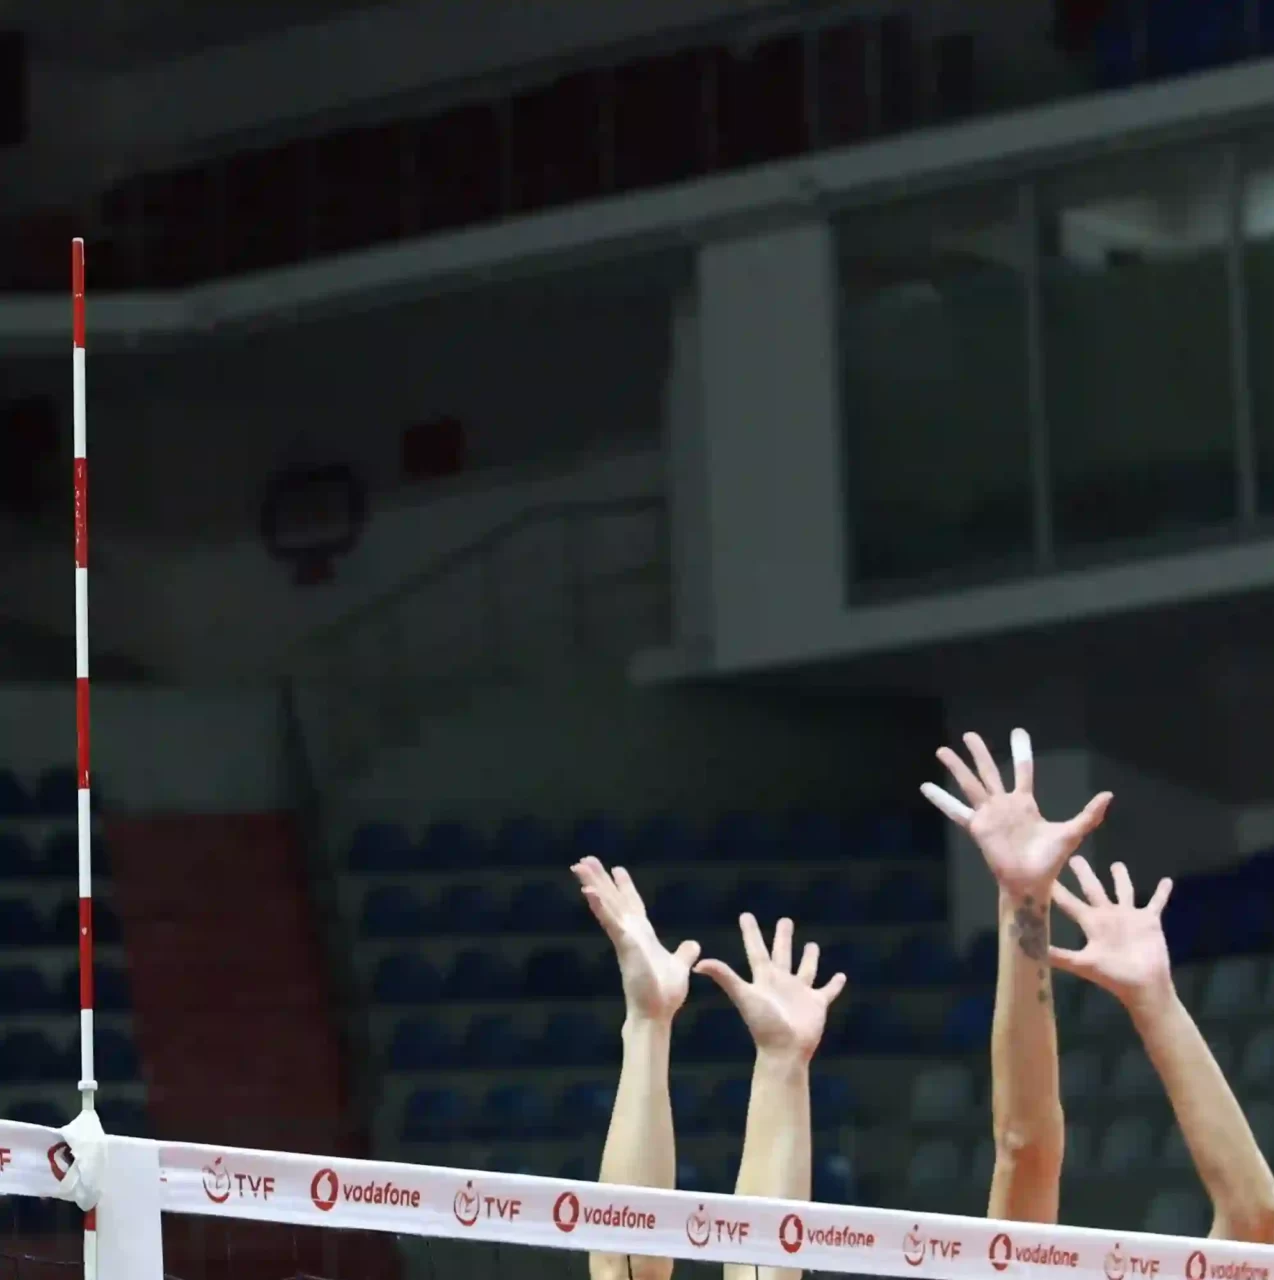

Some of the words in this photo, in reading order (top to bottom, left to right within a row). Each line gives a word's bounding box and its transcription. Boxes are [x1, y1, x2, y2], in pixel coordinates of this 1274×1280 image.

[234, 1173, 275, 1200] TVF
[343, 1181, 420, 1207] vodafone
[484, 1196, 522, 1219] TVF
[584, 1204, 656, 1229] vodafone
[715, 1219, 750, 1244] TVF
[807, 1226, 875, 1248] vodafone
[929, 1238, 962, 1260] TVF
[1015, 1244, 1080, 1268] vodafone
[1130, 1257, 1160, 1280] TVF
